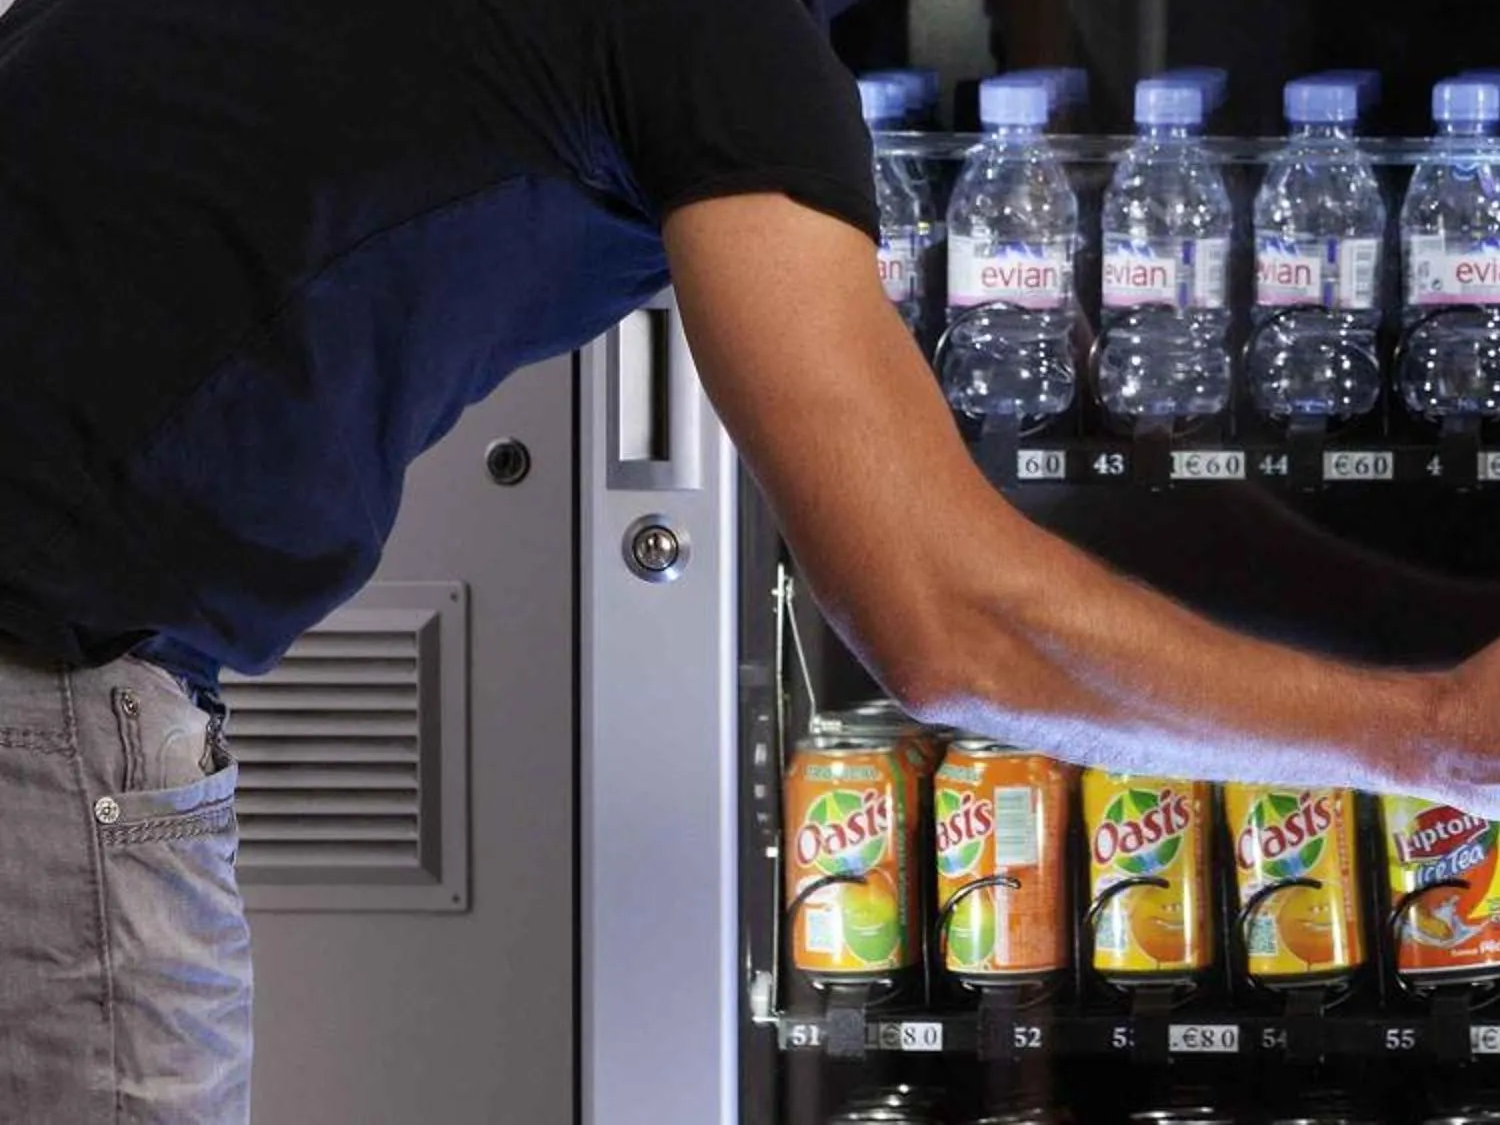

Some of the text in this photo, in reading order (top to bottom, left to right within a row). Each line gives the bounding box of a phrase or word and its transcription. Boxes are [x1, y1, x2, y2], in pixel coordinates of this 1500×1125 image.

[981, 258, 1060, 288] evian
[1025, 454, 1062, 474] 60
[1093, 454, 1124, 475] 43
[1258, 455, 1289, 475] 44
[1334, 455, 1388, 475] €60
[1426, 454, 1442, 476] 4
[797, 790, 894, 865] Oasis
[937, 793, 993, 852] asis
[1094, 789, 1192, 864] Oasis
[1398, 810, 1487, 859] Lipton
[1448, 843, 1485, 879] Tea
[792, 1023, 821, 1046] 51
[1014, 1026, 1042, 1048] 52
[1111, 1027, 1135, 1049] 5
[1385, 1028, 1416, 1050] 55
